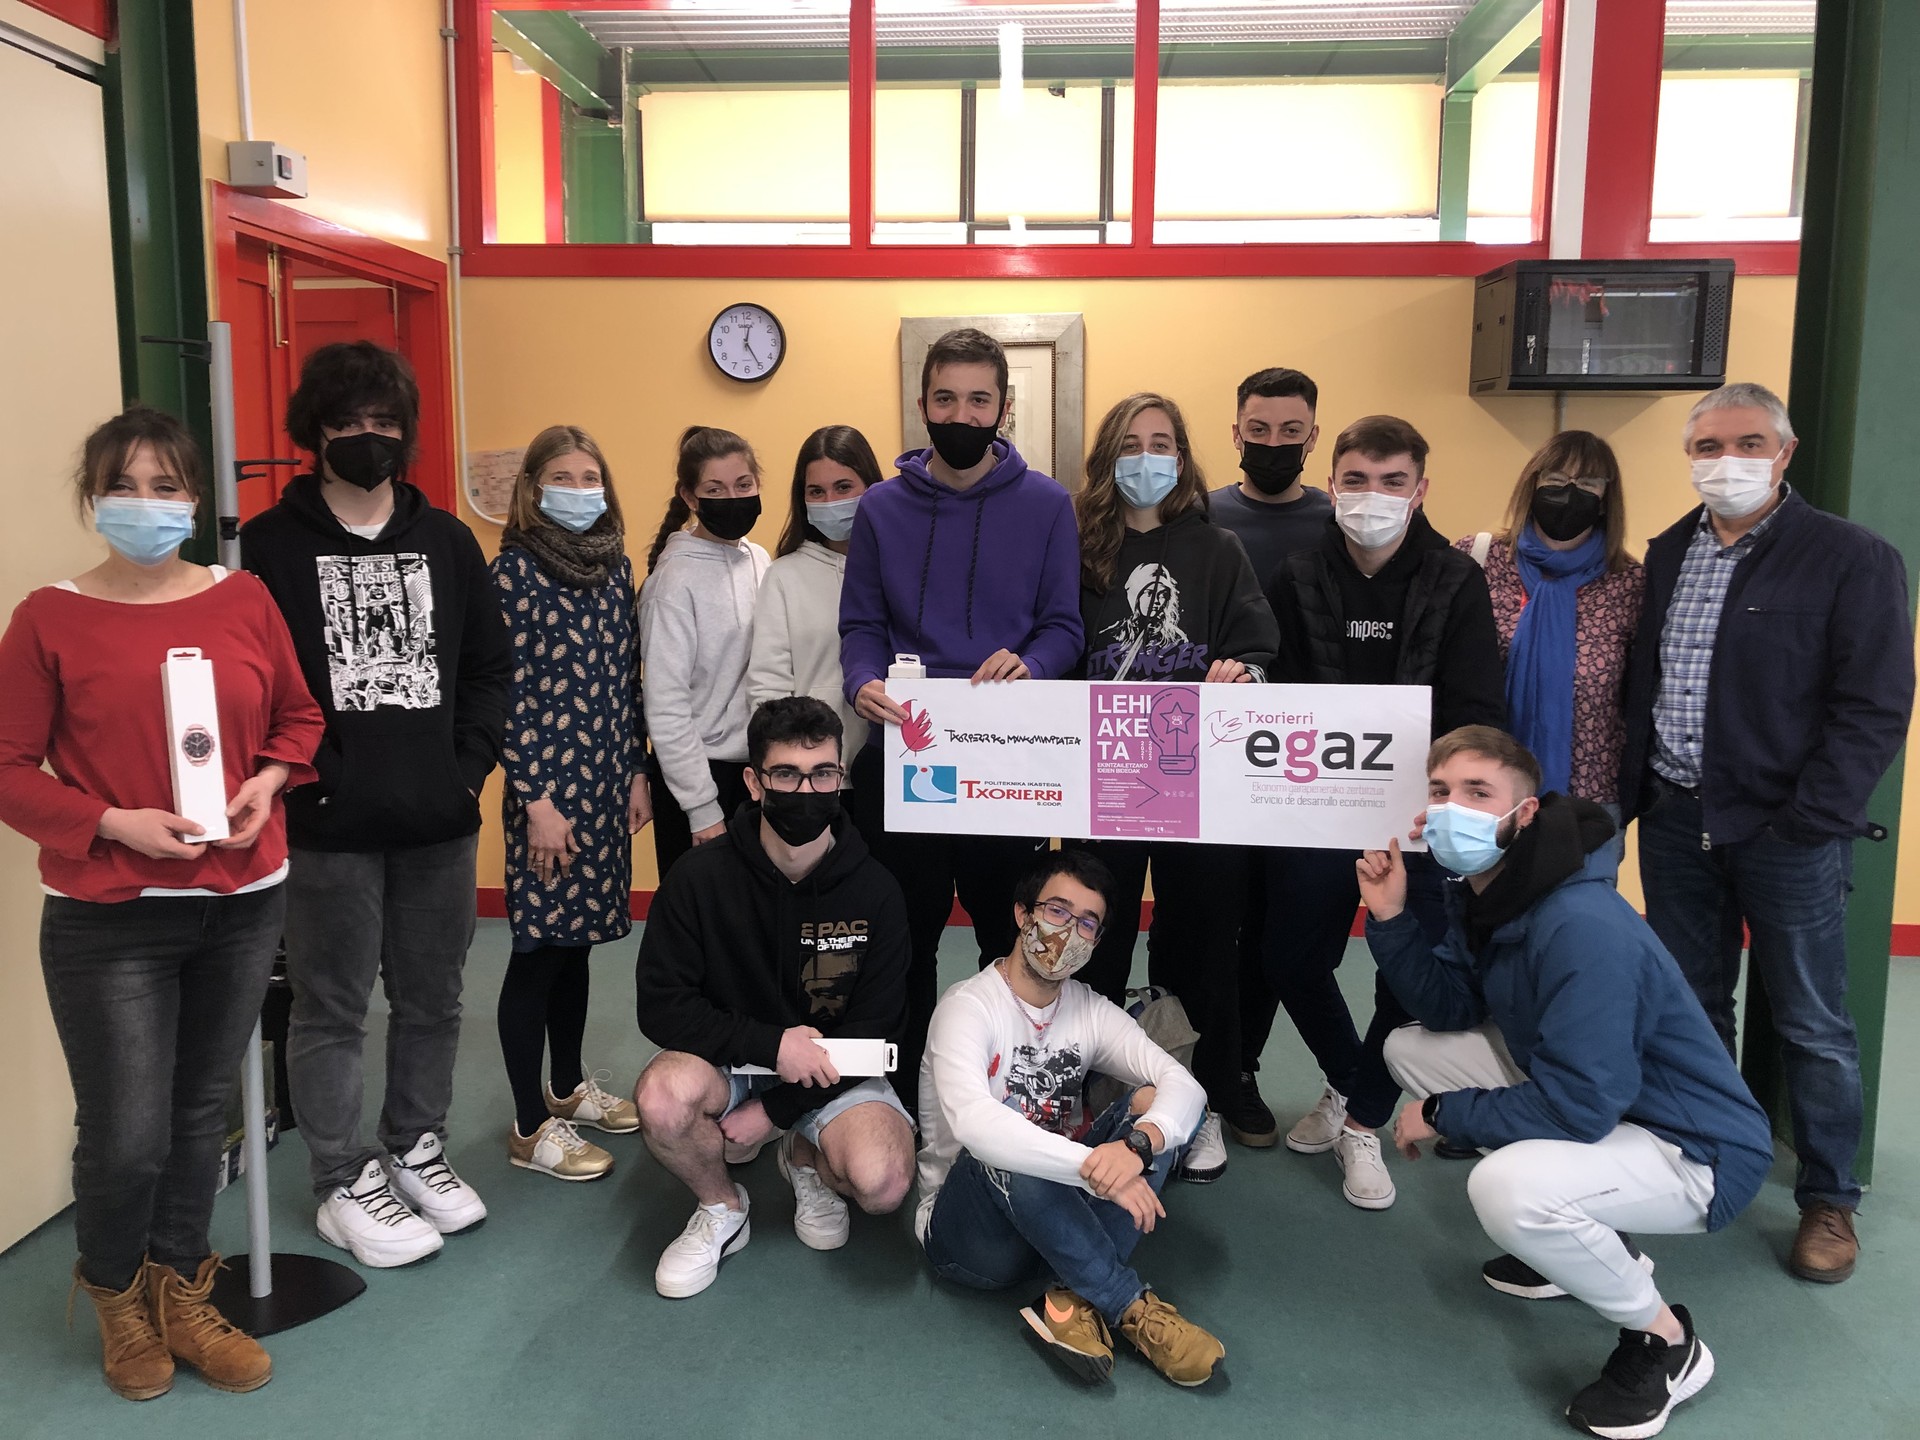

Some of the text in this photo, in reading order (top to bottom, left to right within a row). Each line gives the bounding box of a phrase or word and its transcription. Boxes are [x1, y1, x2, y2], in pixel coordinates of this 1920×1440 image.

[730, 315, 738, 324] 11
[741, 311, 752, 321] 12
[720, 325, 730, 334] 10
[766, 325, 773, 334] 2
[716, 338, 723, 347] 9
[770, 338, 777, 347] 3
[721, 352, 728, 361] 8
[767, 352, 773, 361] 4
[731, 362, 738, 370] 7
[744, 365, 751, 374] 6
[757, 361, 764, 370] 5
[353, 570, 401, 584] BUSTERS
[1097, 694, 1152, 714] LEHI
[1245, 711, 1314, 725] Txorierri
[1097, 717, 1150, 738] AKE
[1096, 740, 1130, 761] TA
[1245, 729, 1394, 784] egaz
[1250, 794, 1387, 809] Servicio de desarrollo económico
